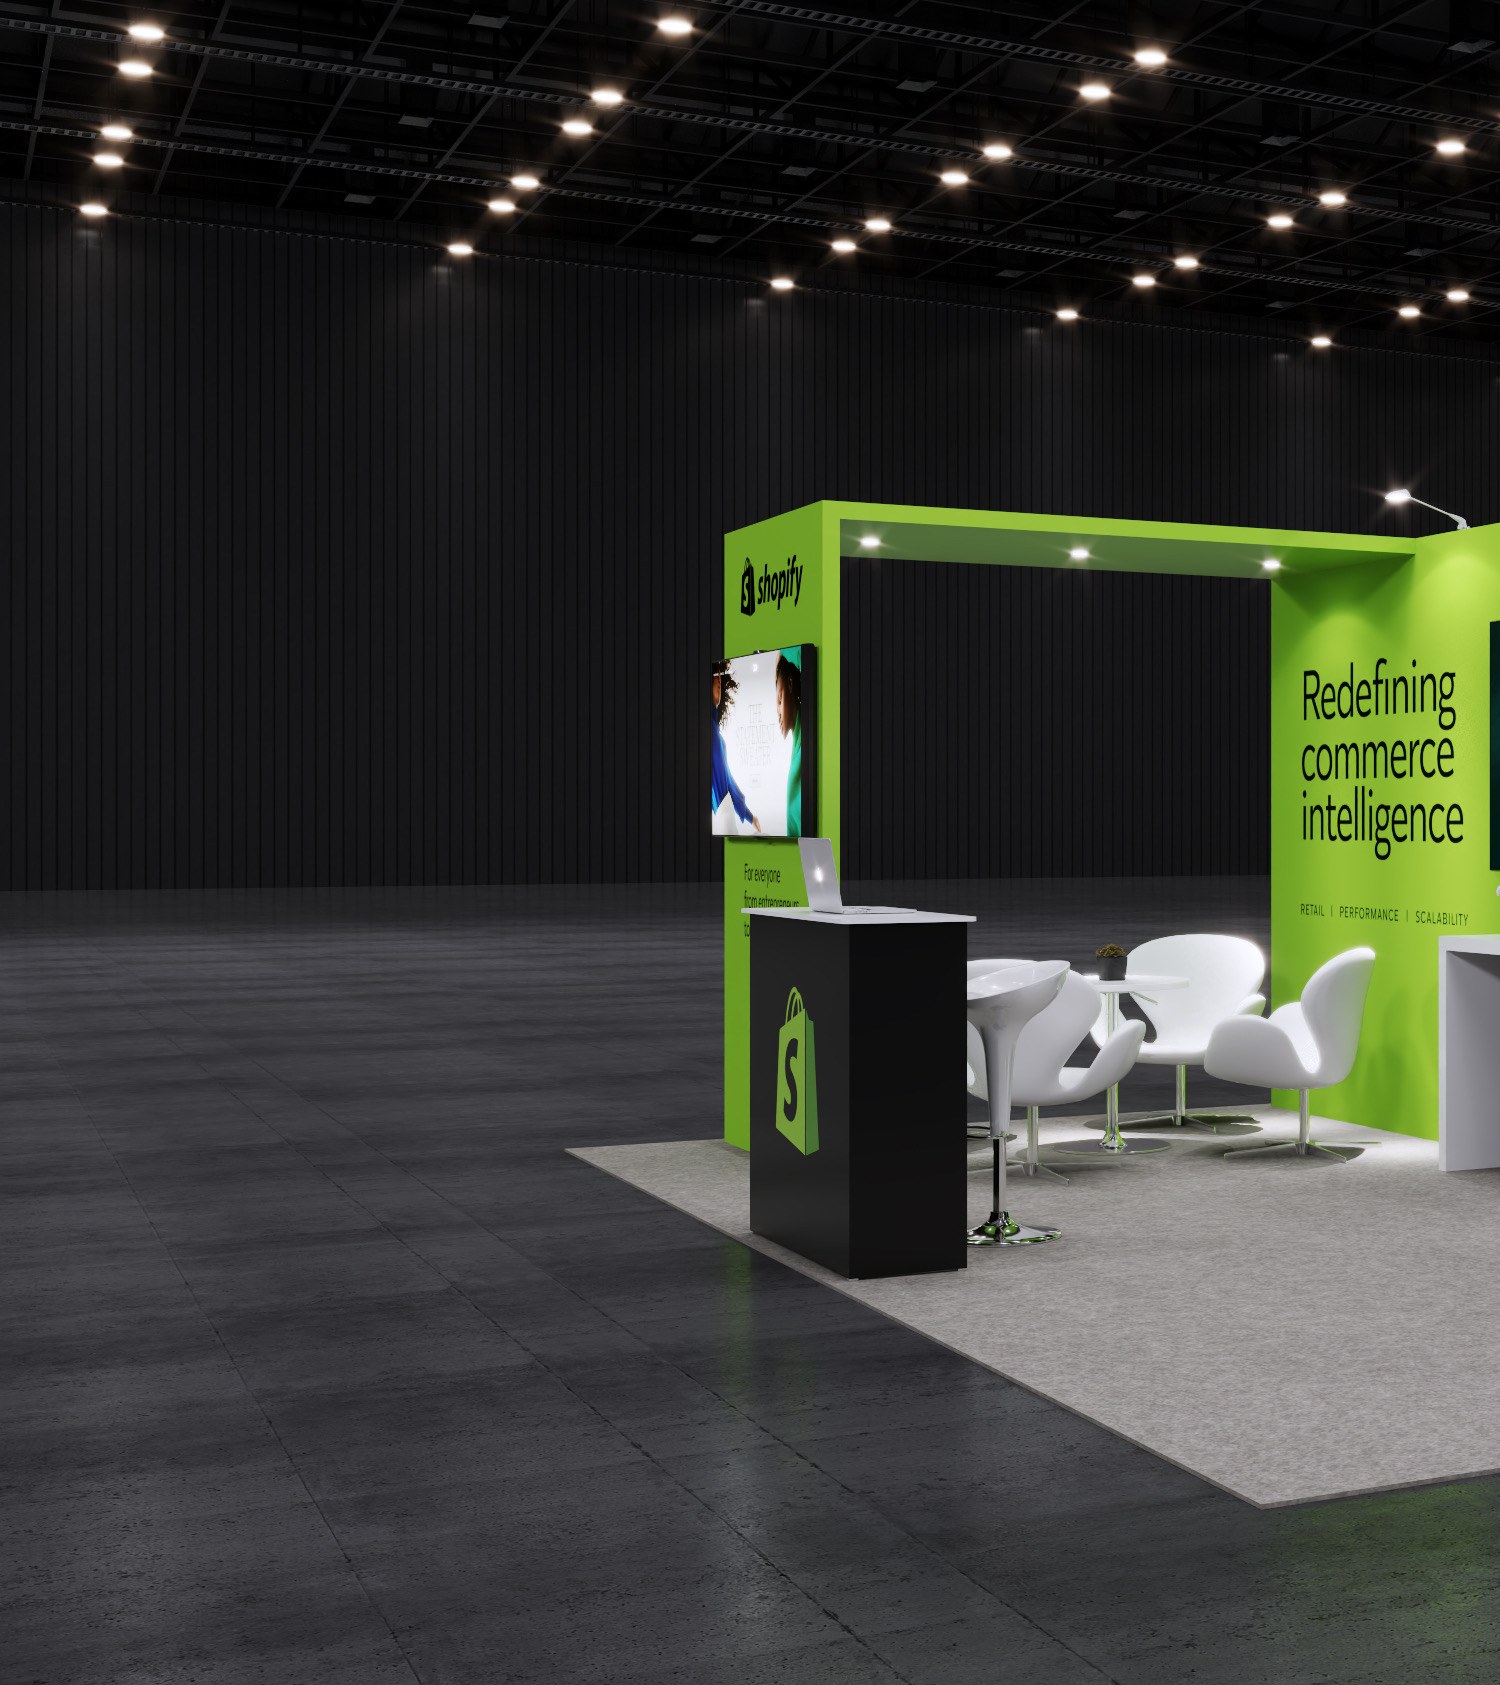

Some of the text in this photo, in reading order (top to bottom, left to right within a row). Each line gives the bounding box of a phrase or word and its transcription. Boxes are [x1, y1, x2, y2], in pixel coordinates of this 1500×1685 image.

[757, 554, 803, 610] shopify
[1303, 658, 1456, 730] Redefining
[1302, 737, 1455, 781] commerce
[1303, 786, 1464, 860] intelligence
[744, 863, 781, 888] For everyone
[1300, 903, 1469, 926] RETAIL PERFORMANCE SCALABILITY
